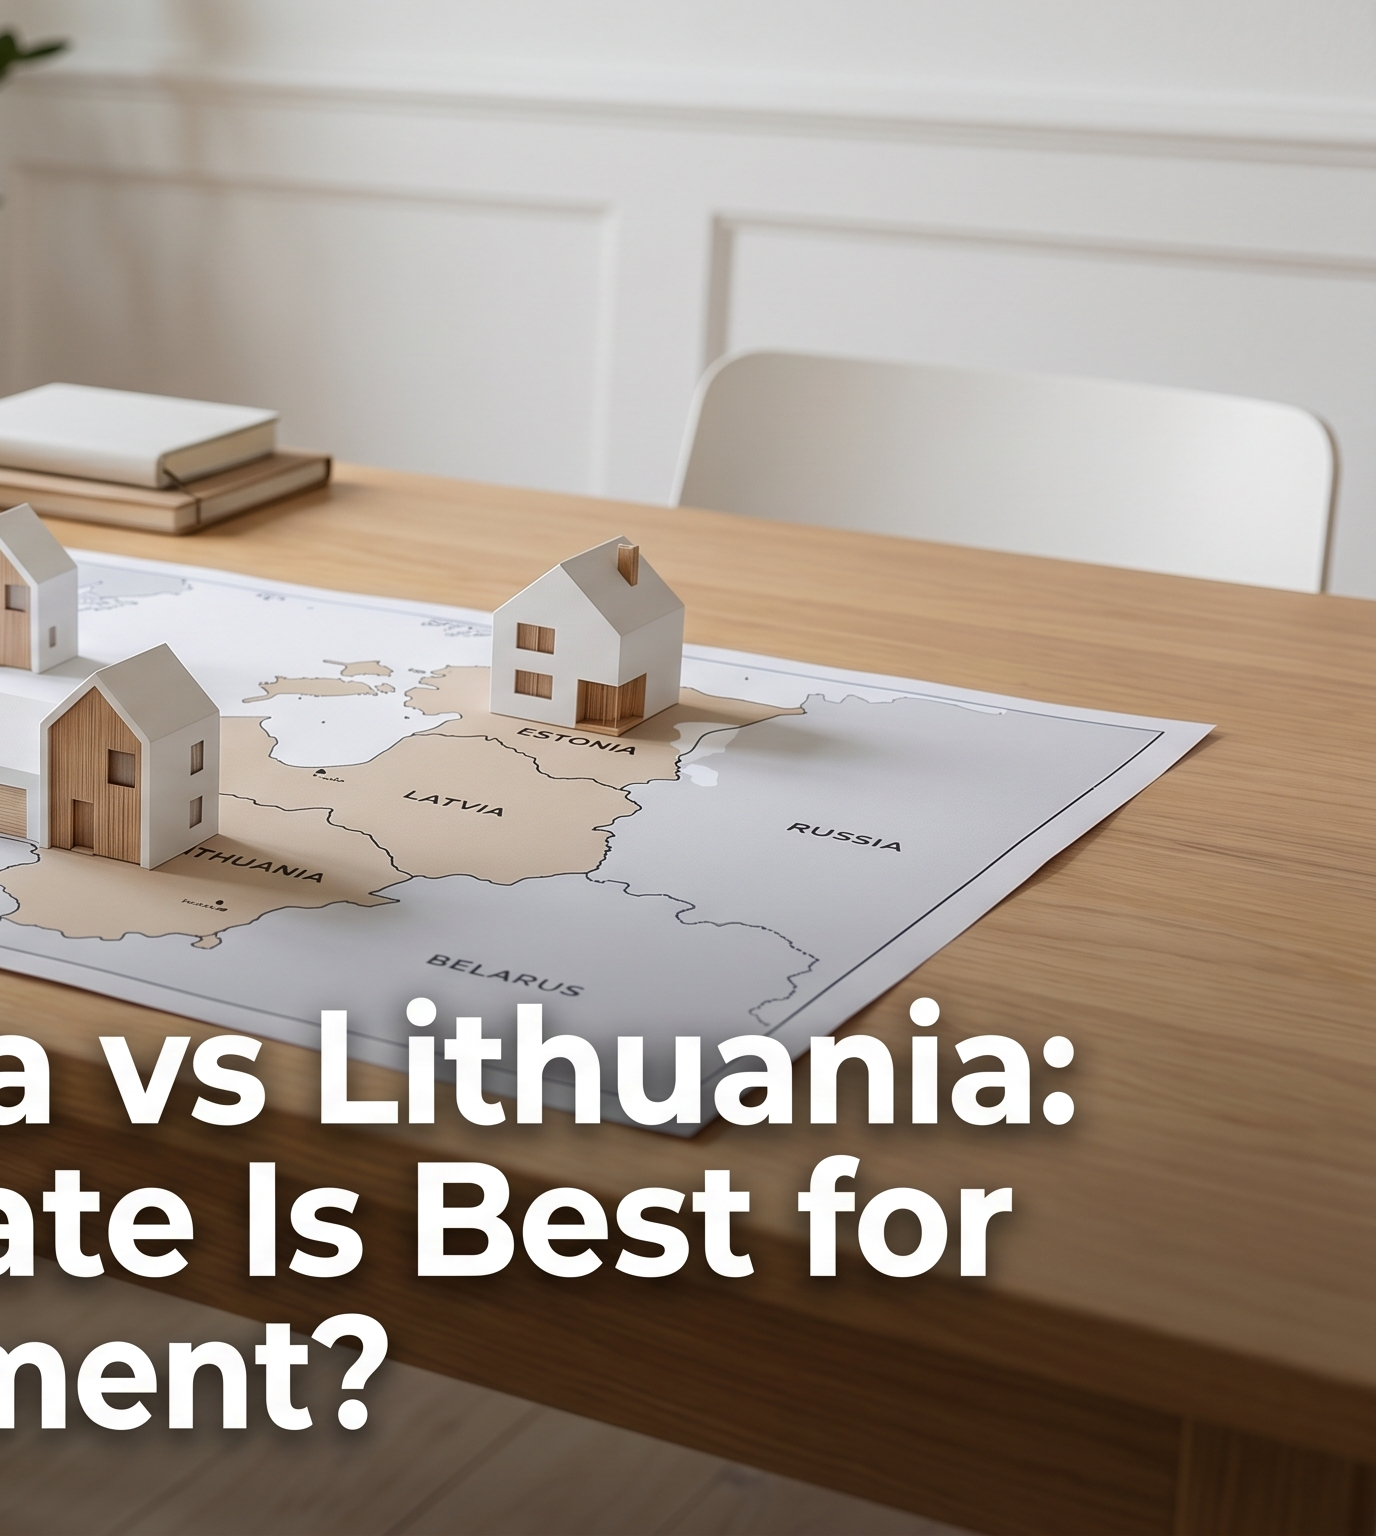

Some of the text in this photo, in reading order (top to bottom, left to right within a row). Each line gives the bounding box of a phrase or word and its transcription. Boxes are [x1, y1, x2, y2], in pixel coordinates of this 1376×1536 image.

[516, 727, 636, 756] ESTONIA
[403, 790, 503, 817] LATVIA
[786, 822, 901, 852] RUSSIA
[184, 846, 324, 884] ITHUANIA
[426, 953, 585, 997] BELARUS
